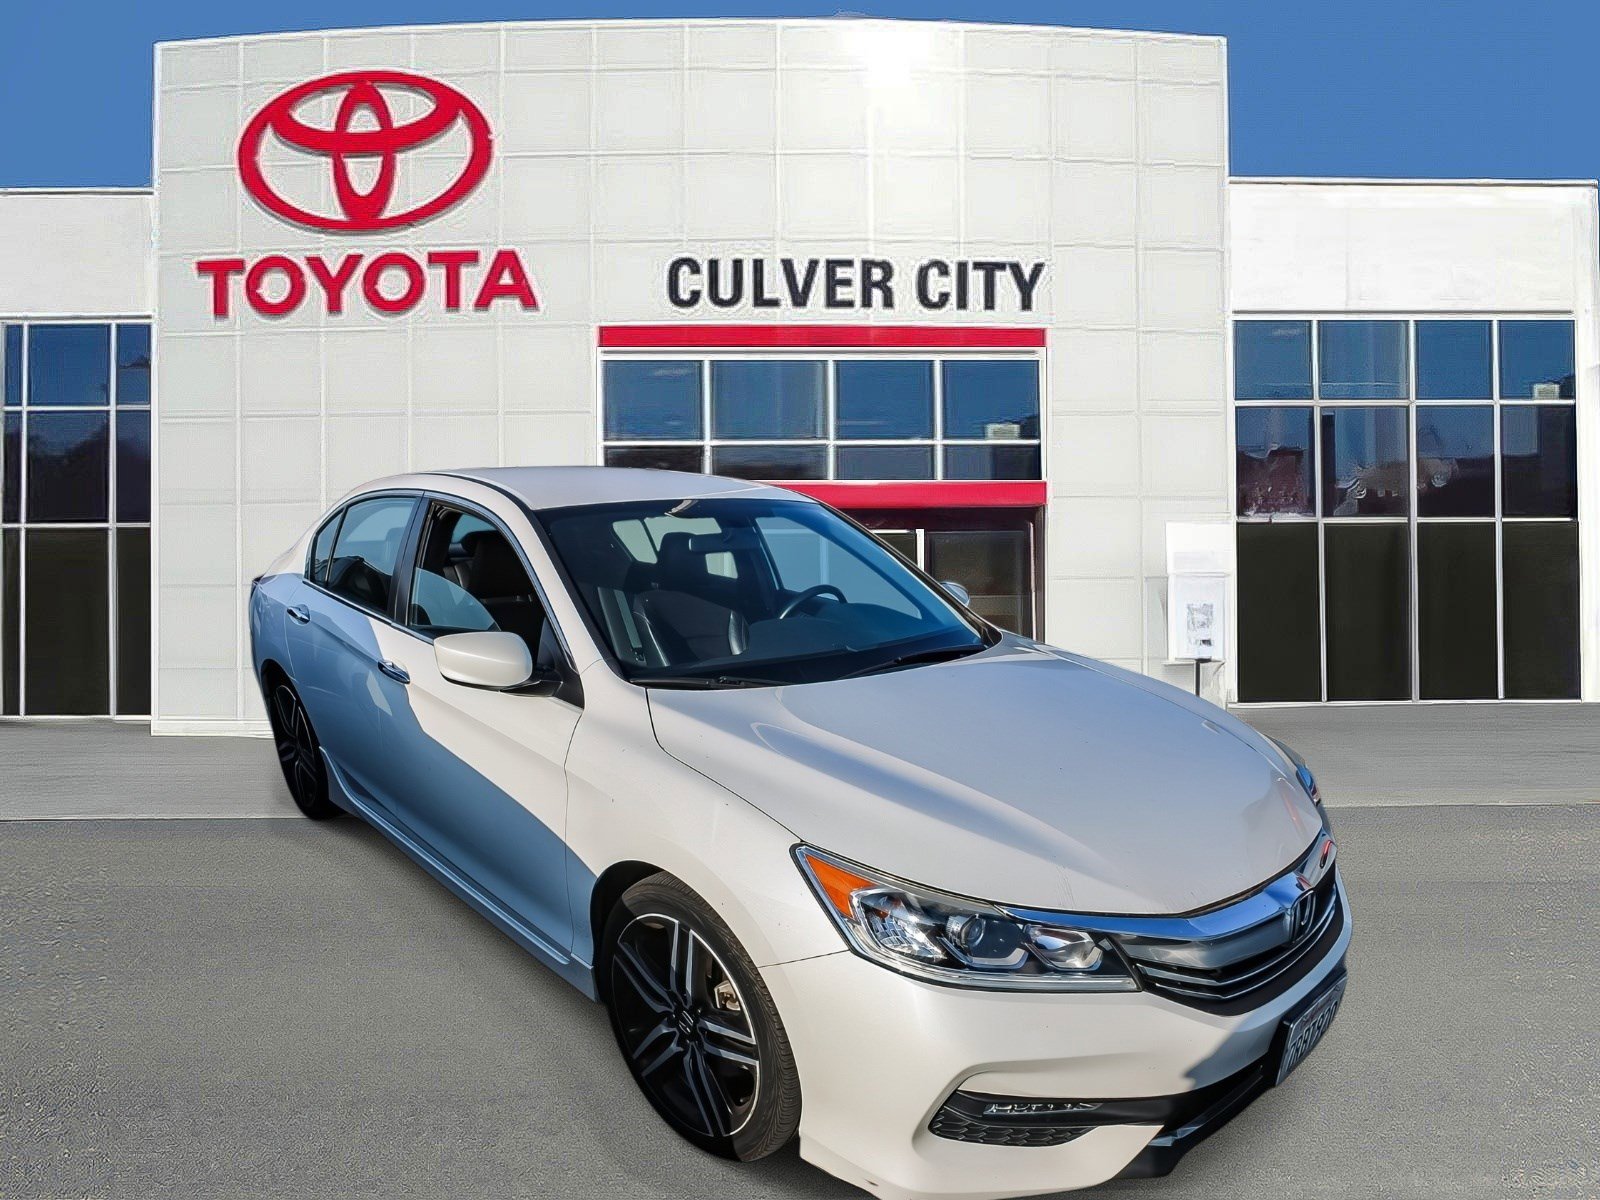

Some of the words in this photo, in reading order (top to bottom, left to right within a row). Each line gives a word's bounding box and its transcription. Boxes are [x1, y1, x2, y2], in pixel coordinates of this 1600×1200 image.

[195, 249, 538, 317] TOYOTA
[667, 257, 895, 309] CULVER
[916, 259, 1046, 311] CITY
